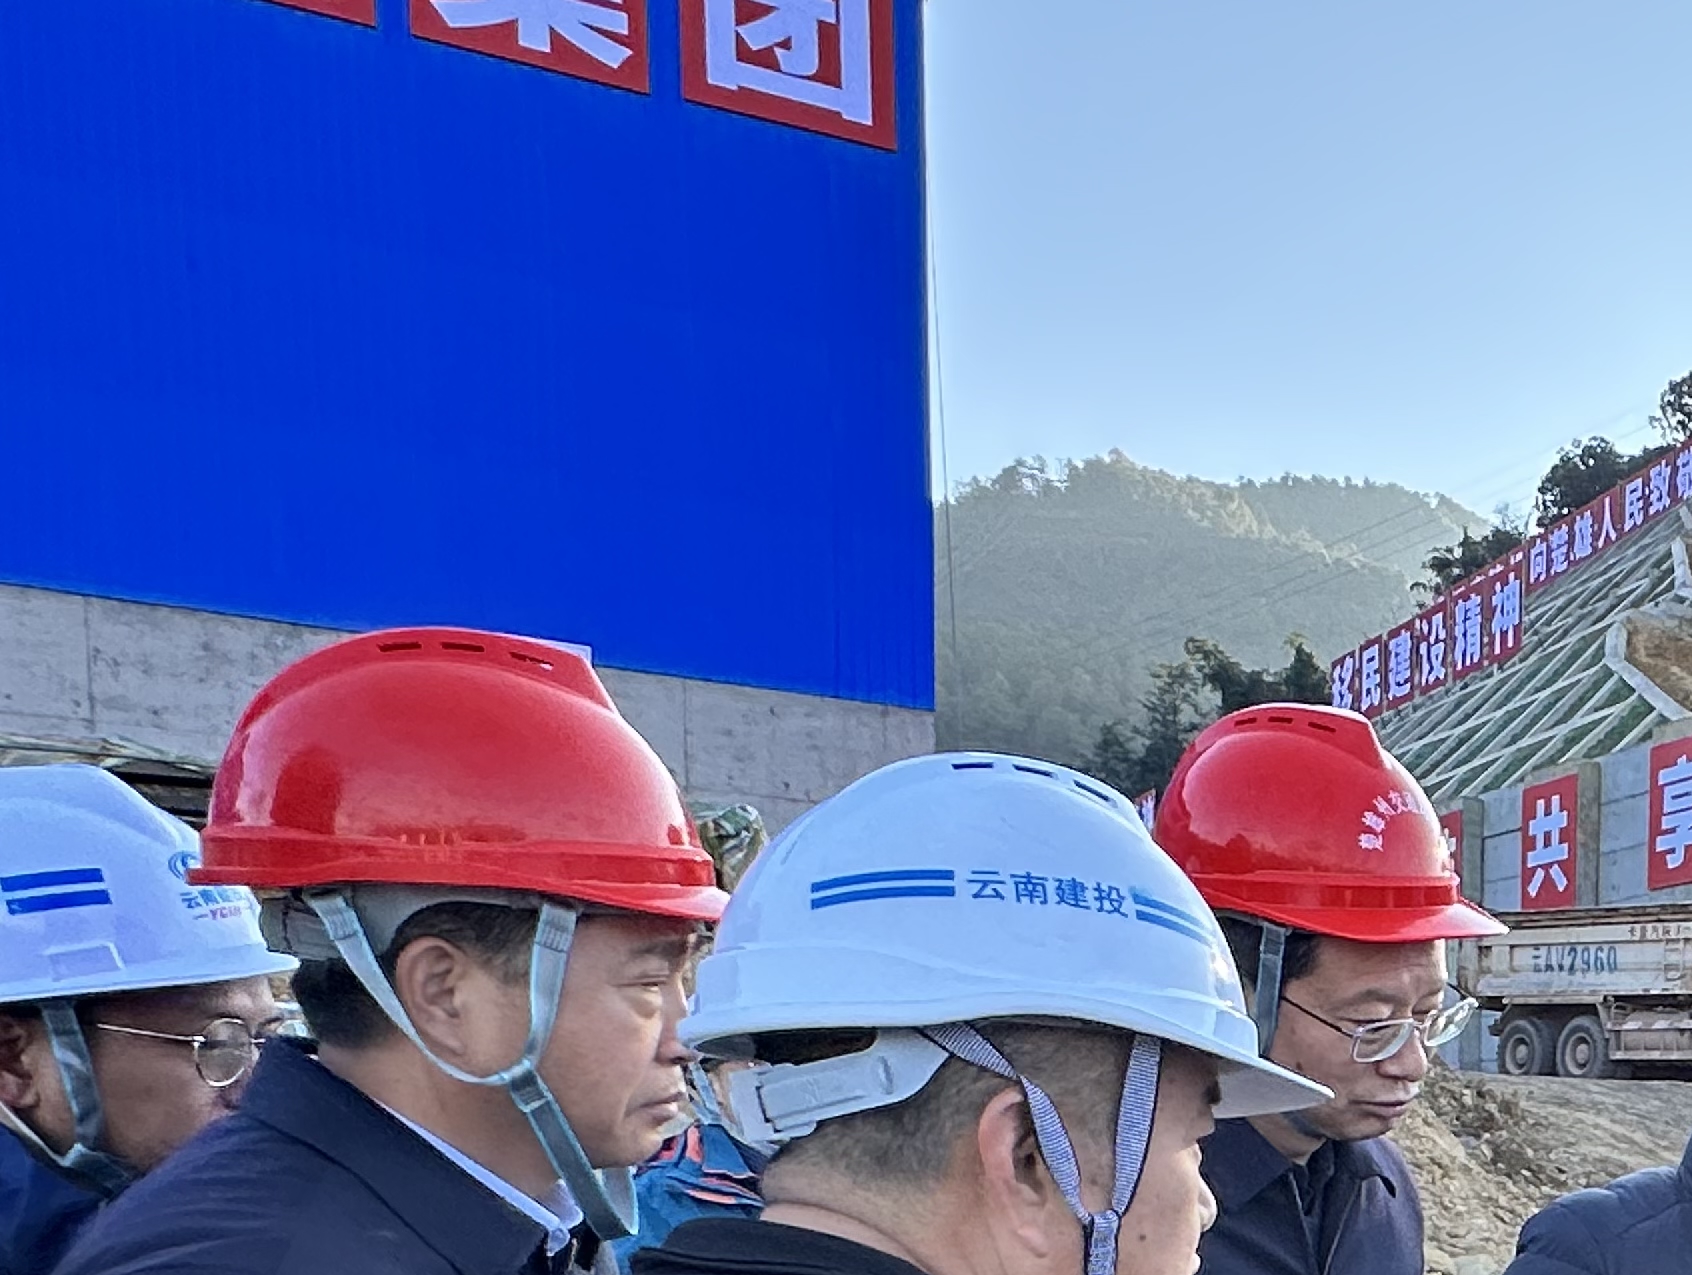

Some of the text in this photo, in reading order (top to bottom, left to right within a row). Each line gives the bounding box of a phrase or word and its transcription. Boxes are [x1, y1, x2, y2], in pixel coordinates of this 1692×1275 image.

[1332, 572, 1520, 712] 移民建设精神
[966, 869, 1129, 919] 云南建投
